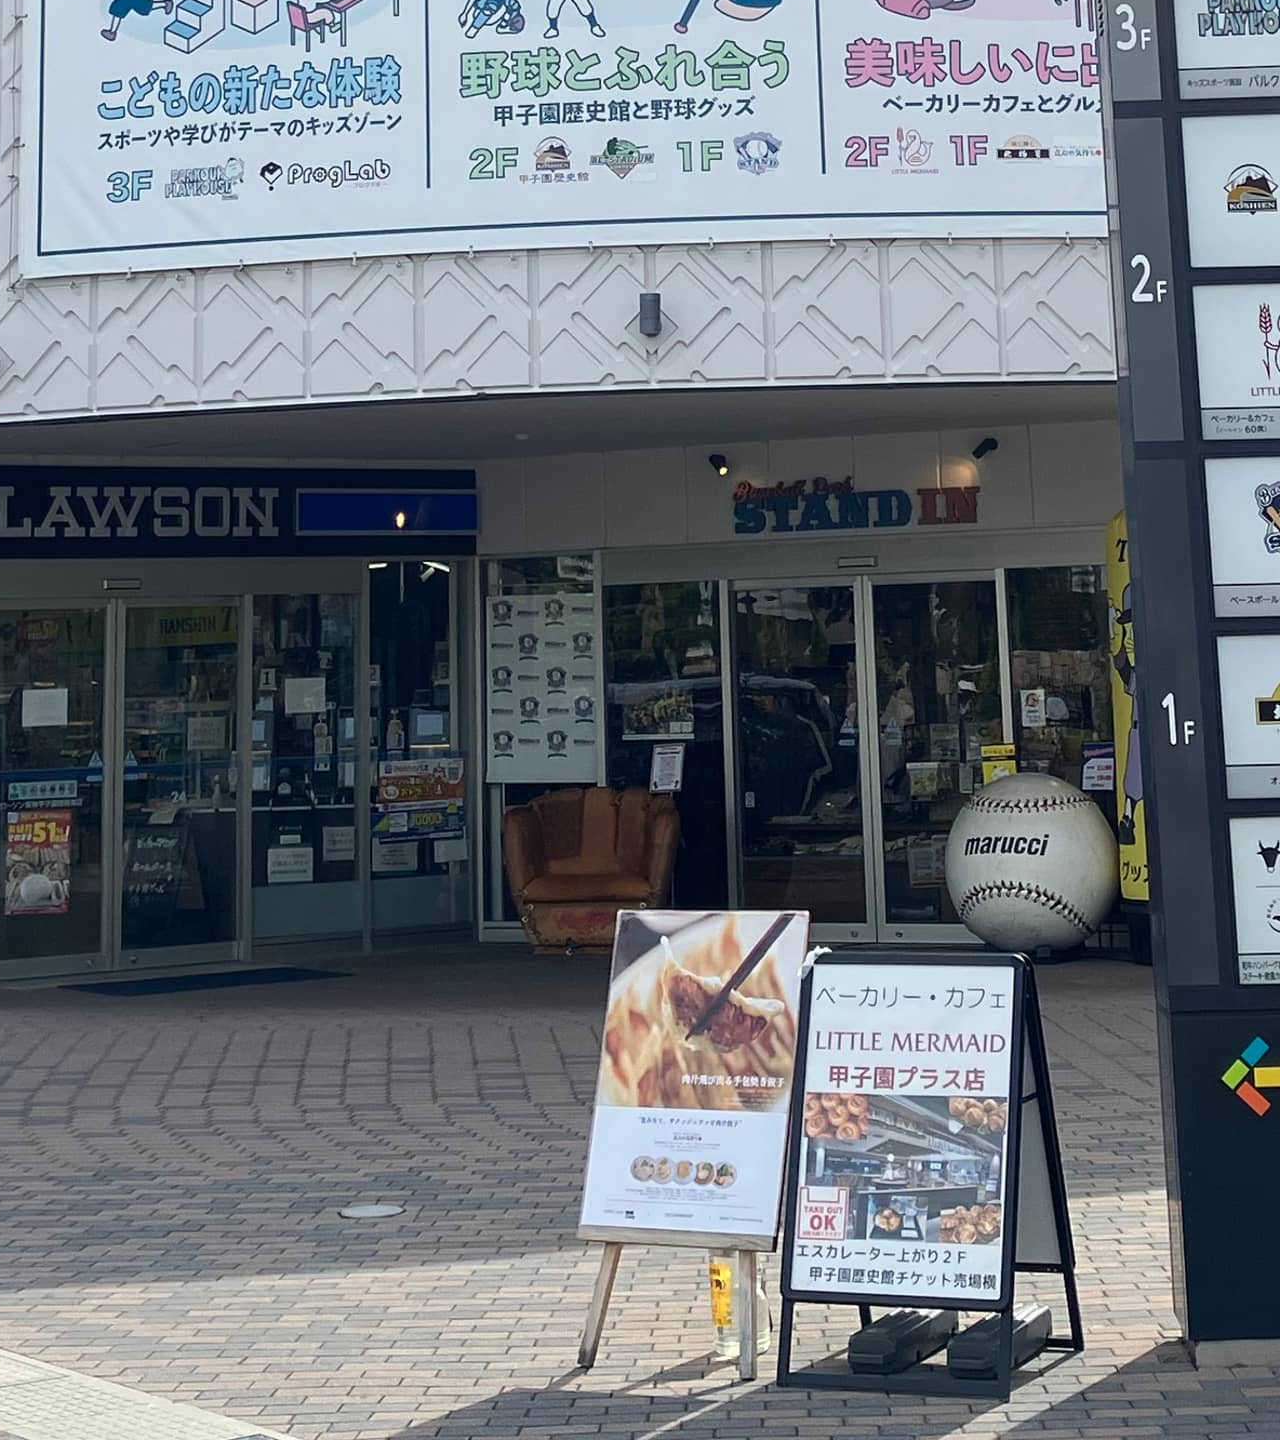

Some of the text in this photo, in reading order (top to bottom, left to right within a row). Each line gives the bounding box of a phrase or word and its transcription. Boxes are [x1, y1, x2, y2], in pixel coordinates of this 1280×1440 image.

[1115, 3, 1151, 51] 3F
[459, 39, 790, 100] 野球とふれ合う
[97, 54, 403, 121] こどもの新たな体験
[493, 95, 756, 128] 甲子園歴史館と野球グッズ
[97, 113, 403, 151] スポーツや学びがテーマのキッズゾーン
[469, 147, 519, 180] 2F
[676, 140, 724, 172] 1F
[845, 136, 890, 168] 2F
[950, 135, 988, 166] 1F
[106, 170, 154, 203] 3F
[287, 159, 391, 188] ProgLab
[519, 173, 590, 185] 甲子園歴史館
[1228, 200, 1277, 212] KOSHIEN
[1130, 254, 1167, 304] 2F
[733, 486, 981, 534] STAND IN
[1161, 692, 1196, 746] 1F
[964, 833, 1050, 858] marucci
[816, 985, 1007, 1009] ベーカリー・カフェ
[815, 1031, 1006, 1054] LITTLE MERMAID
[829, 1066, 985, 1091] 甲子園プラス店
[804, 1206, 843, 1214] TAKE OUT
[809, 1214, 837, 1231] OK
[809, 1266, 997, 1290] 甲子園歴史館チケット売場横
